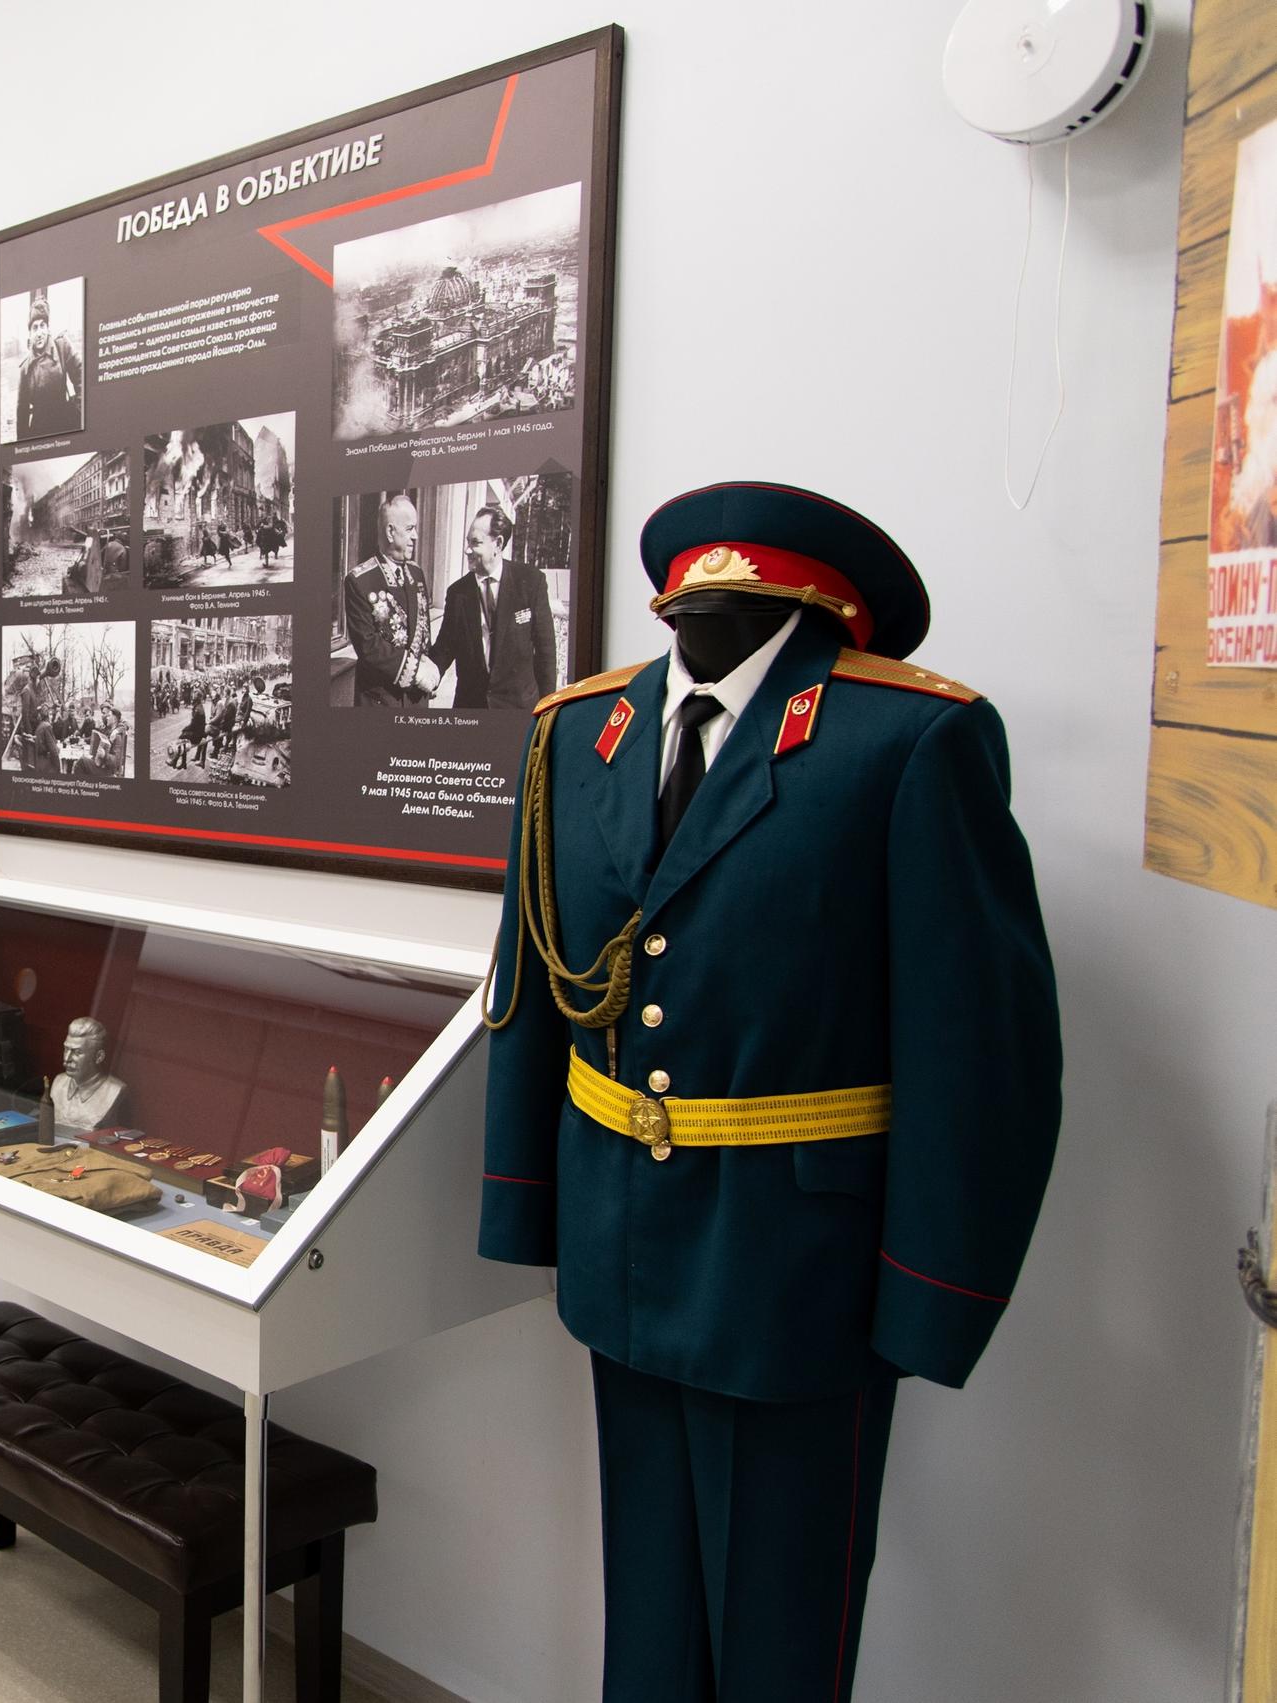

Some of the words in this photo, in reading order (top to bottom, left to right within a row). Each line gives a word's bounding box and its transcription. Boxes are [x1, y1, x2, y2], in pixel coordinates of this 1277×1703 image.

[117, 191, 209, 243] ПОБЕДА
[215, 184, 230, 213] В
[236, 133, 384, 206] ОБЪЕКТИВЕ
[99, 318, 127, 332] Главные
[127, 311, 158, 325] события
[159, 300, 189, 317] военной
[190, 298, 210, 309] поры
[211, 287, 252, 306] регулярно
[99, 328, 141, 345] освещались
[147, 318, 181, 333] находили
[182, 307, 225, 325] отражение
[232, 294, 280, 312] творчестве
[112, 341, 138, 354] Темина
[146, 334, 171, 346] одного
[172, 331, 180, 339] из
[181, 325, 206, 338] самых
[207, 315, 248, 331] известных
[249, 310, 275, 323] фото-
[99, 349, 160, 370] корреспондентов
[162, 339, 205, 355] Советского
[206, 332, 233, 345] Союза,
[235, 322, 277, 340] уроженца
[104, 366, 139, 381] Почетного
[140, 356, 184, 375] гражданина
[185, 350, 211, 364] города
[212, 338, 267, 357] Йошкар-Олы.
[345, 447, 368, 457] Знамя
[369, 442, 397, 453] Победы
[398, 441, 408, 449] на
[409, 434, 455, 449] Рейхстагом.
[457, 430, 486, 443] Берлин
[493, 428, 511, 437] мая
[512, 424, 531, 434] 1945
[532, 421, 555, 432] года.
[411, 449, 430, 459] Фото
[431, 446, 446, 456] В.А.
[447, 443, 478, 455] Темина
[228, 591, 251, 599] Апрель
[252, 589, 266, 597] 1945
[189, 602, 204, 610] Фото
[395, 716, 406, 724] Г.К.
[408, 715, 431, 727] Жуков
[438, 716, 453, 725] В.А.
[454, 717, 479, 726] Темин
[389, 757, 426, 769] Указом
[428, 758, 491, 773] Президиума
[377, 771, 432, 785] Верховного
[434, 774, 472, 787] Совета
[475, 777, 506, 788] СССР
[169, 787, 187, 796] Парад
[188, 789, 216, 798] советских
[217, 790, 233, 798] войск
[361, 785, 368, 795] 9
[368, 787, 387, 797] мая
[390, 786, 411, 798] 1945
[413, 790, 436, 800] года
[438, 790, 464, 802] было
[190, 798, 202, 806] 1945
[208, 800, 222, 808] Фото
[235, 801, 259, 810] Темина
[402, 803, 429, 816] Днем
[432, 805, 475, 818] Победы.
[176, 1229, 244, 1255] ПРАВДА
